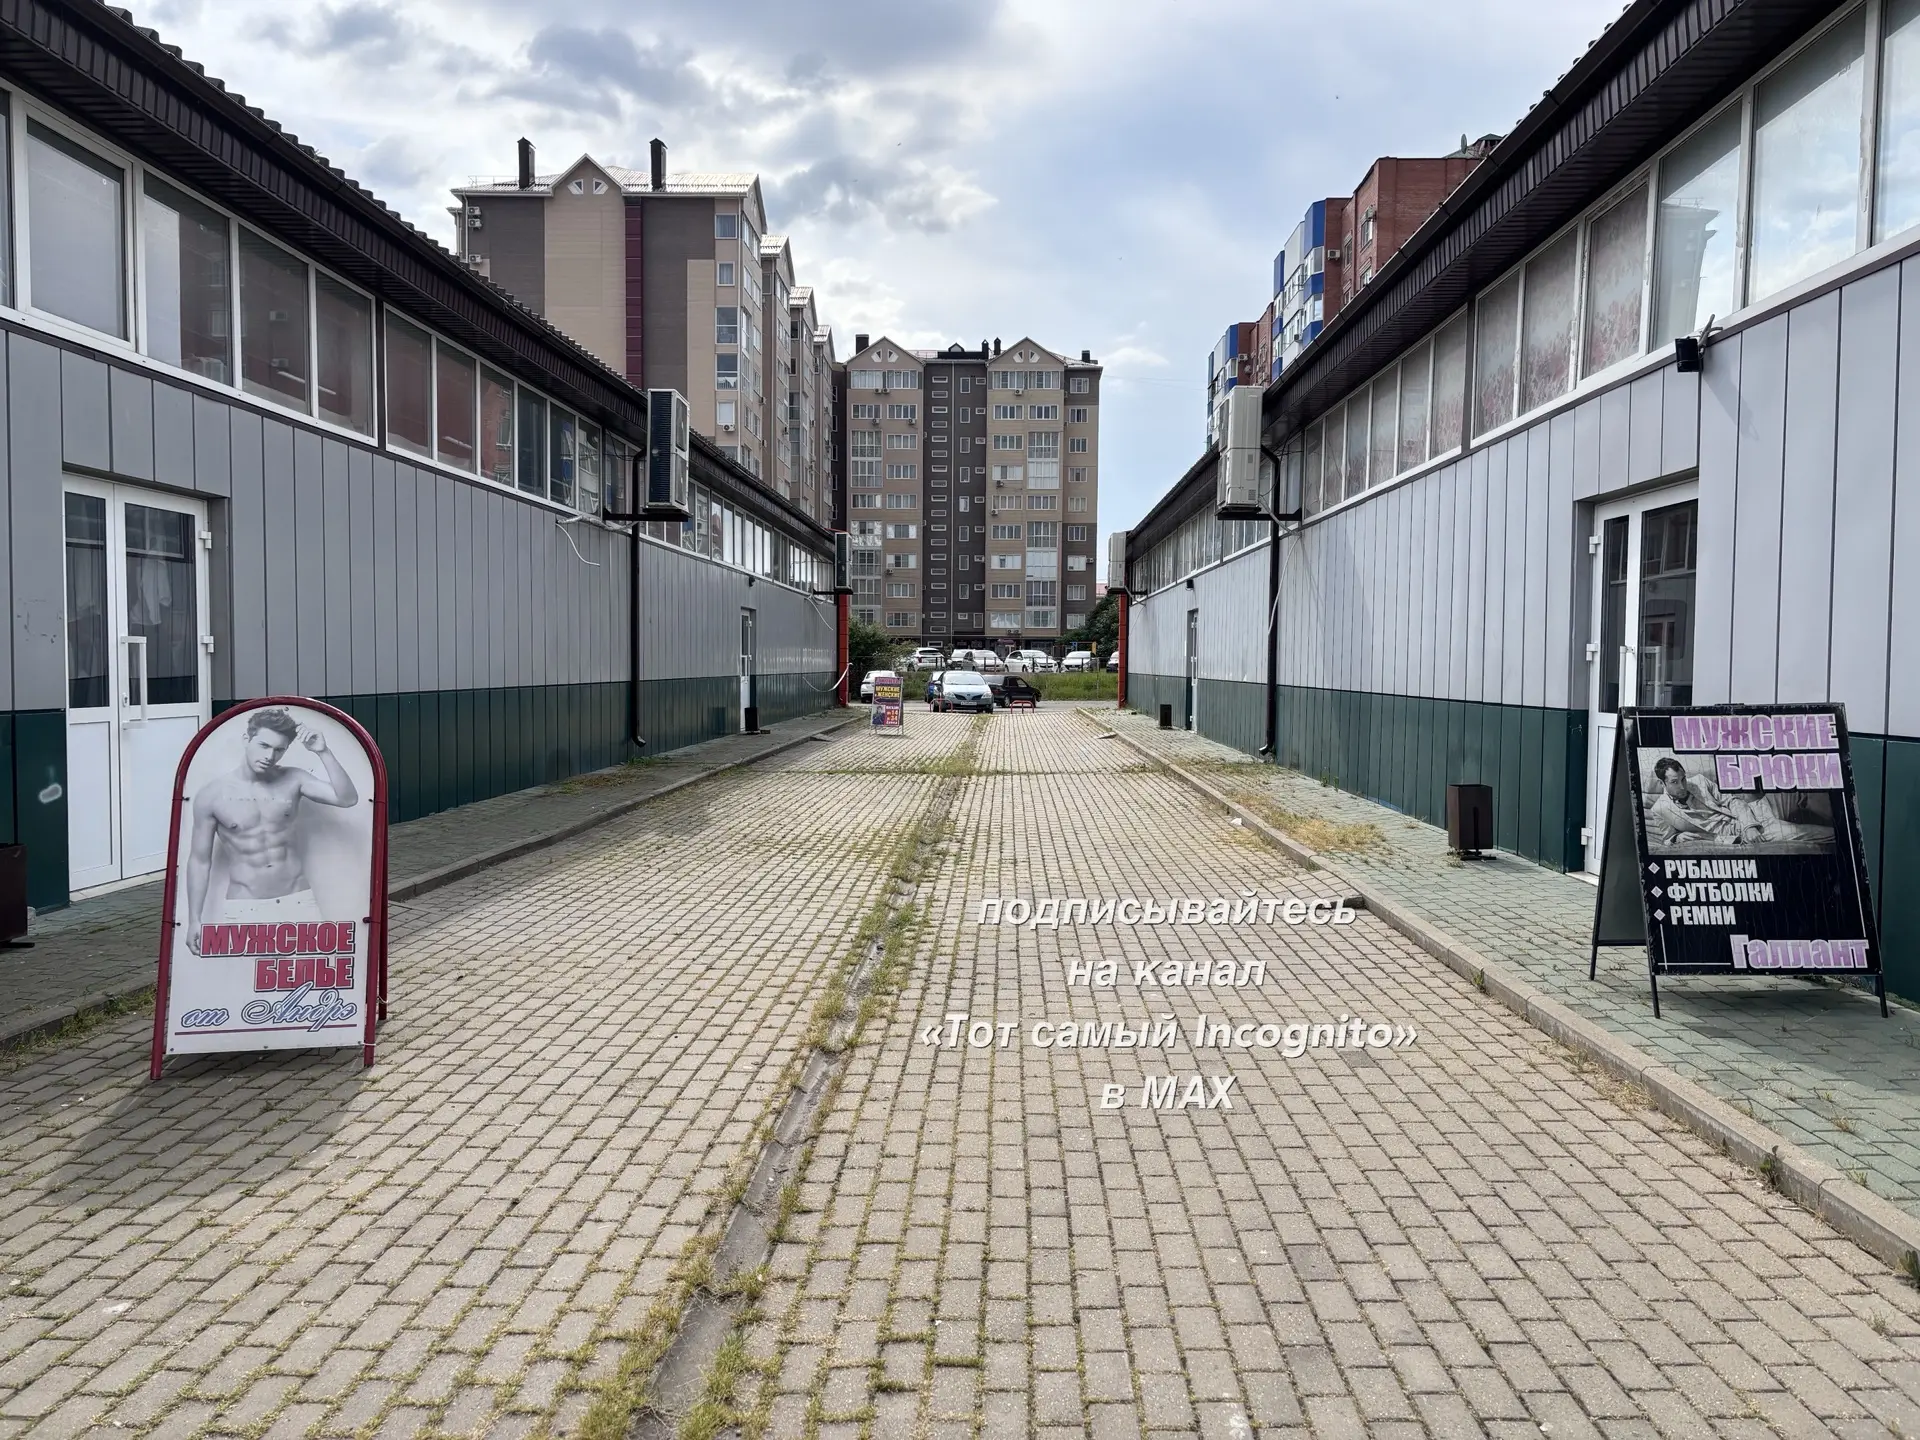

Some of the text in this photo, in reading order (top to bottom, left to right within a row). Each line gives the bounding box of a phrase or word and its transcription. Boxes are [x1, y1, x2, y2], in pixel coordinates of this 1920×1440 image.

[1670, 713, 1839, 751] МУЖСКИЕ
[1715, 753, 1844, 790] БРЮКИ
[1664, 859, 1758, 879] РУБАШКИ
[1667, 882, 1775, 902] ФУТБОЛКИ
[1669, 905, 1737, 925] РЕМНИ
[200, 921, 356, 957] МУЖСКОЕ
[1729, 934, 1870, 969] Галлант
[254, 956, 354, 992] БЕЛЬЕ
[181, 981, 357, 1032] от Андрэ
